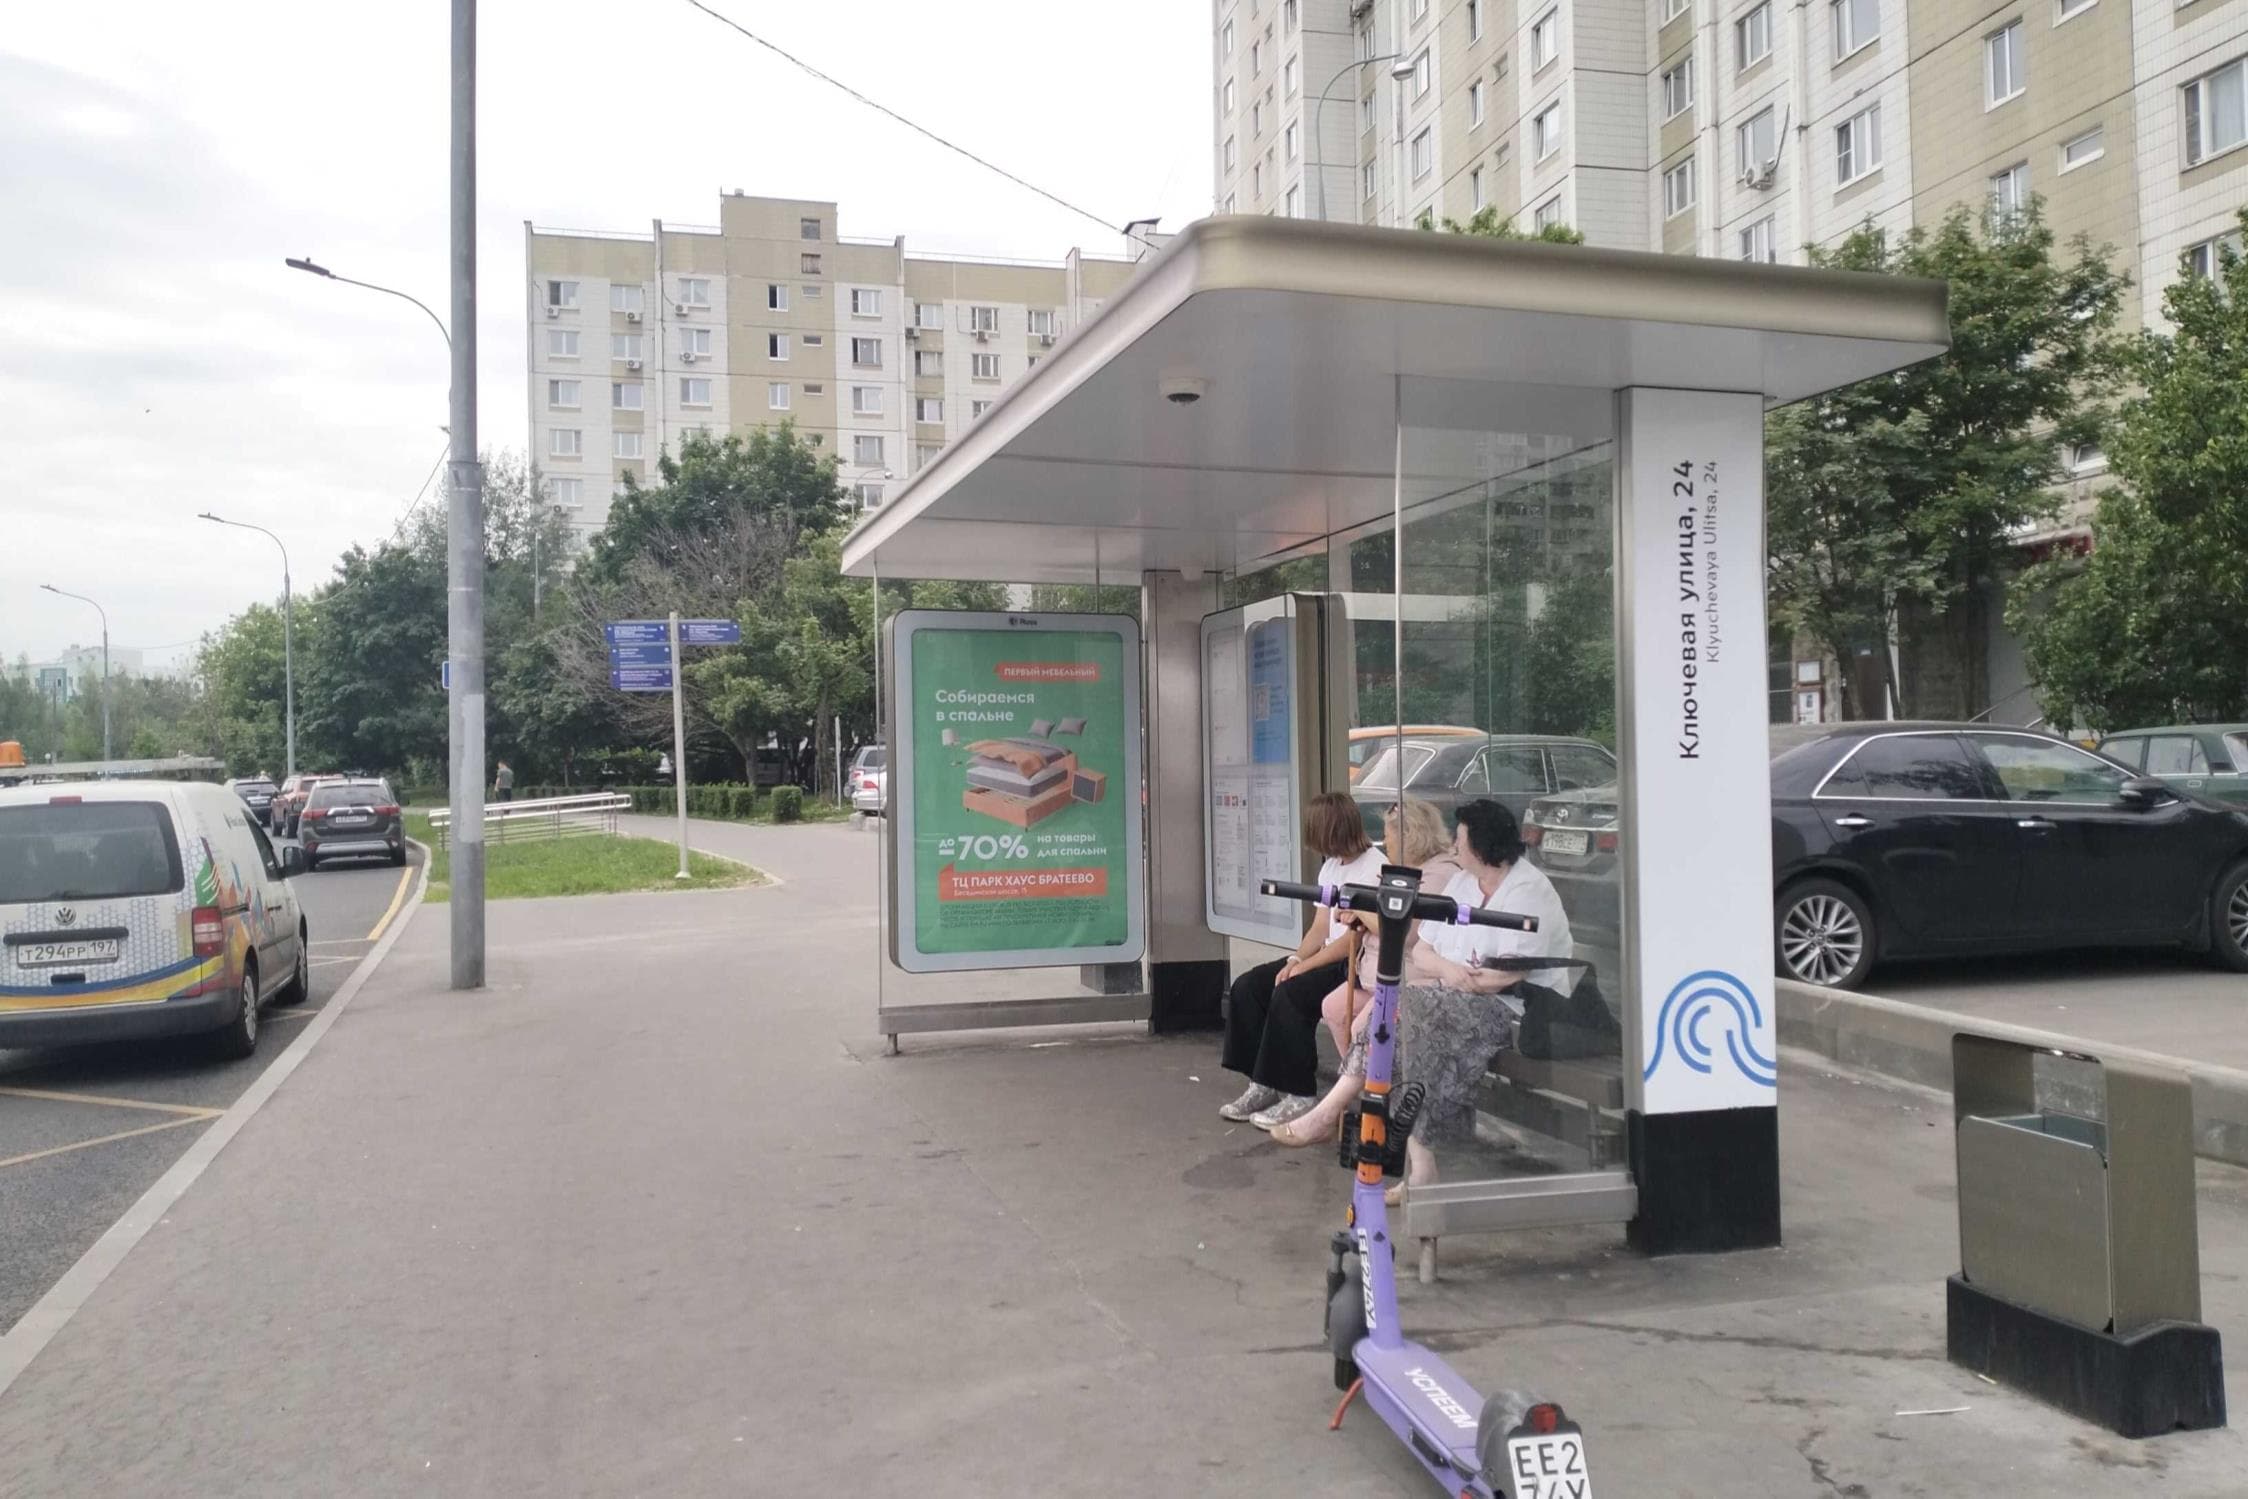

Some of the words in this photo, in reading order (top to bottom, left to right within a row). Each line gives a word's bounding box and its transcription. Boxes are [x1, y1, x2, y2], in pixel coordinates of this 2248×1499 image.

[1673, 460, 1693, 497] 24
[1704, 461, 1718, 483] 24
[1703, 489, 1719, 545] Ulitsa,
[1679, 506, 1700, 602] улица,
[1704, 551, 1722, 662] Klyuchevaya
[1004, 666, 1040, 677] ПЕРВЫЙ
[1041, 666, 1096, 677] МЕБЕЛЬНЫЙ
[1679, 613, 1699, 759] Ключевая
[935, 689, 1035, 706] Собираемся
[936, 711, 945, 722] в
[949, 711, 1015, 722] спальне
[939, 838, 955, 849] до
[1037, 834, 1052, 843] на
[1054, 834, 1096, 844] товары
[1037, 849, 1058, 858] для
[1060, 848, 1107, 857] спальни
[952, 877, 968, 888] ТЦ
[971, 876, 1003, 887] ПАРК
[1005, 875, 1036, 886] ХАУС
[1039, 873, 1095, 885] БРАТЕЕВО
[25, 944, 86, 961] Т294РР
[90, 941, 113, 953] 197
[1404, 1367, 1479, 1429] УСПЕЕМ
[1515, 1441, 1582, 1478] ЕЕ2
